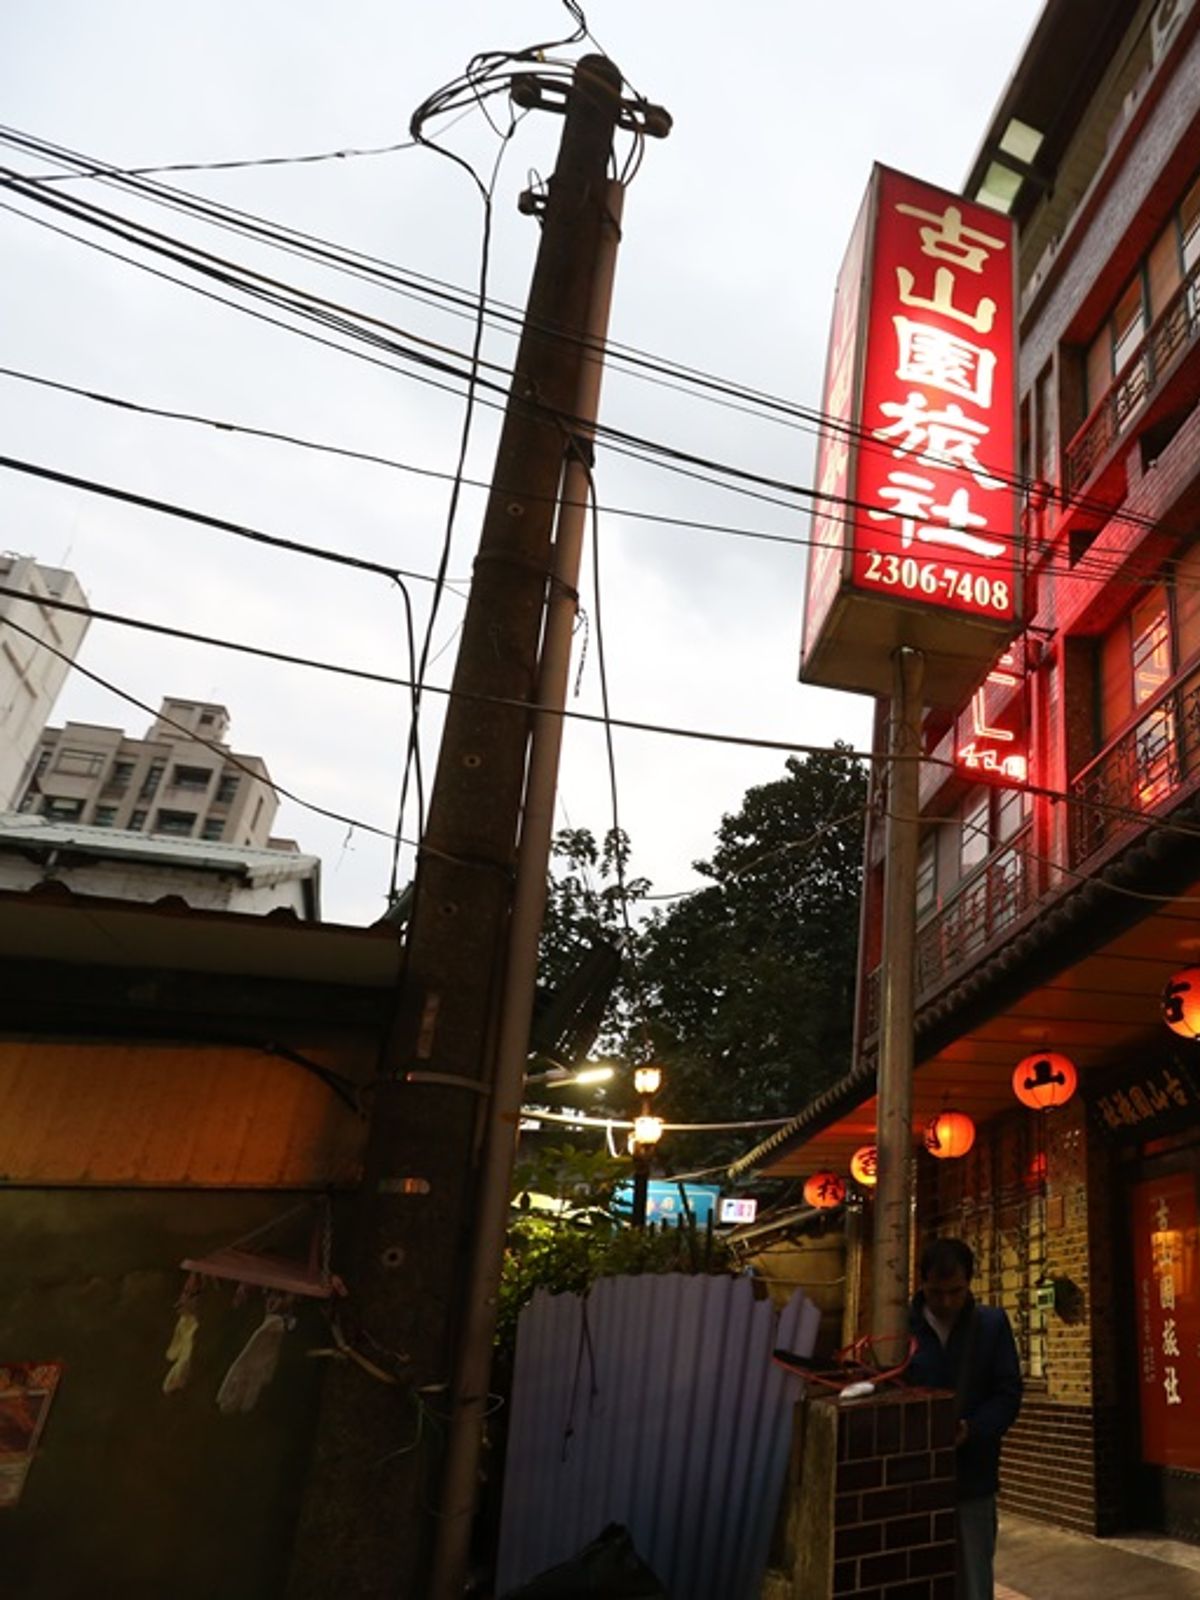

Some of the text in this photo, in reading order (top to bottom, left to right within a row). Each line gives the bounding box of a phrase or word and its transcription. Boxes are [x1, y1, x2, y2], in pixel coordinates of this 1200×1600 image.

[869, 202, 1007, 558] 古山園旅社
[862, 549, 1010, 611] 2306-7408
